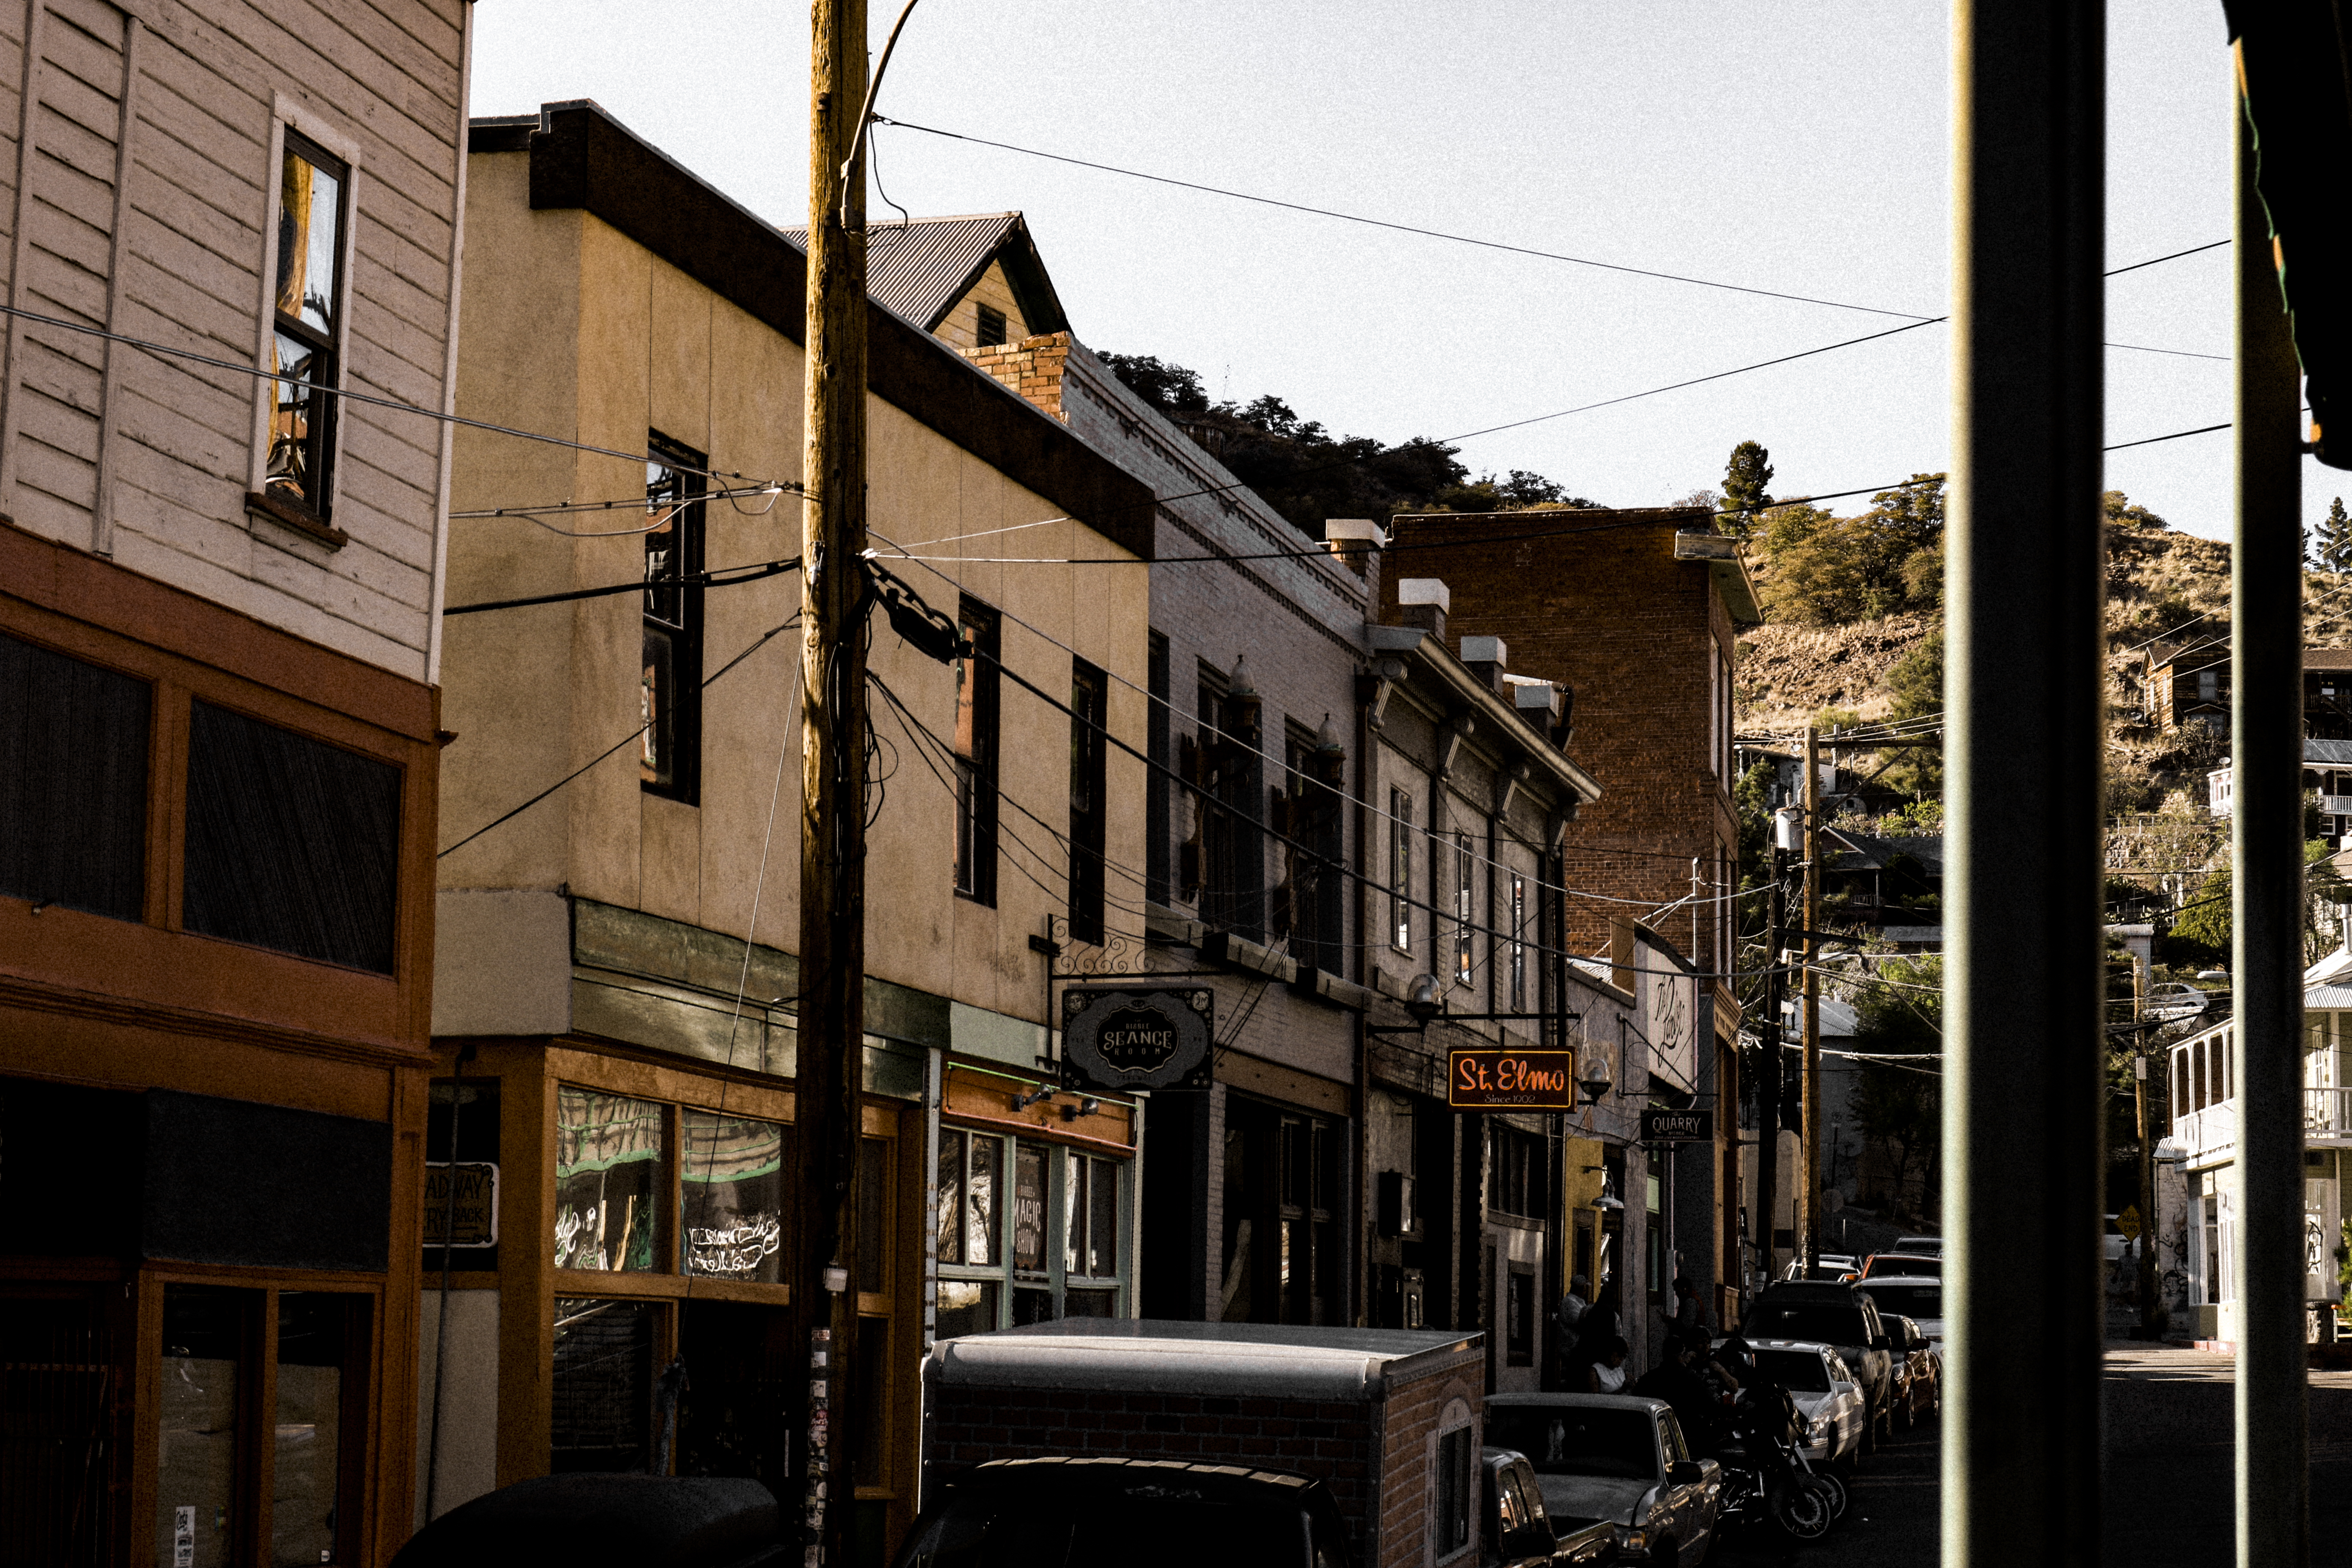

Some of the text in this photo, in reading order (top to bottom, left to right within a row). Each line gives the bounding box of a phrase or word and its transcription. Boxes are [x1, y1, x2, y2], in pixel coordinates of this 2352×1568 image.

[1103, 1031, 1172, 1051] SEANCE
[1114, 1047, 1161, 1056] ROOM
[1497, 1058, 1564, 1091] Elmo
[1485, 1094, 1535, 1104] Since 1902
[1652, 1117, 1702, 1134] QUARRY
[452, 1207, 483, 1223] BACK
[1017, 1228, 1035, 1254] SHOW
